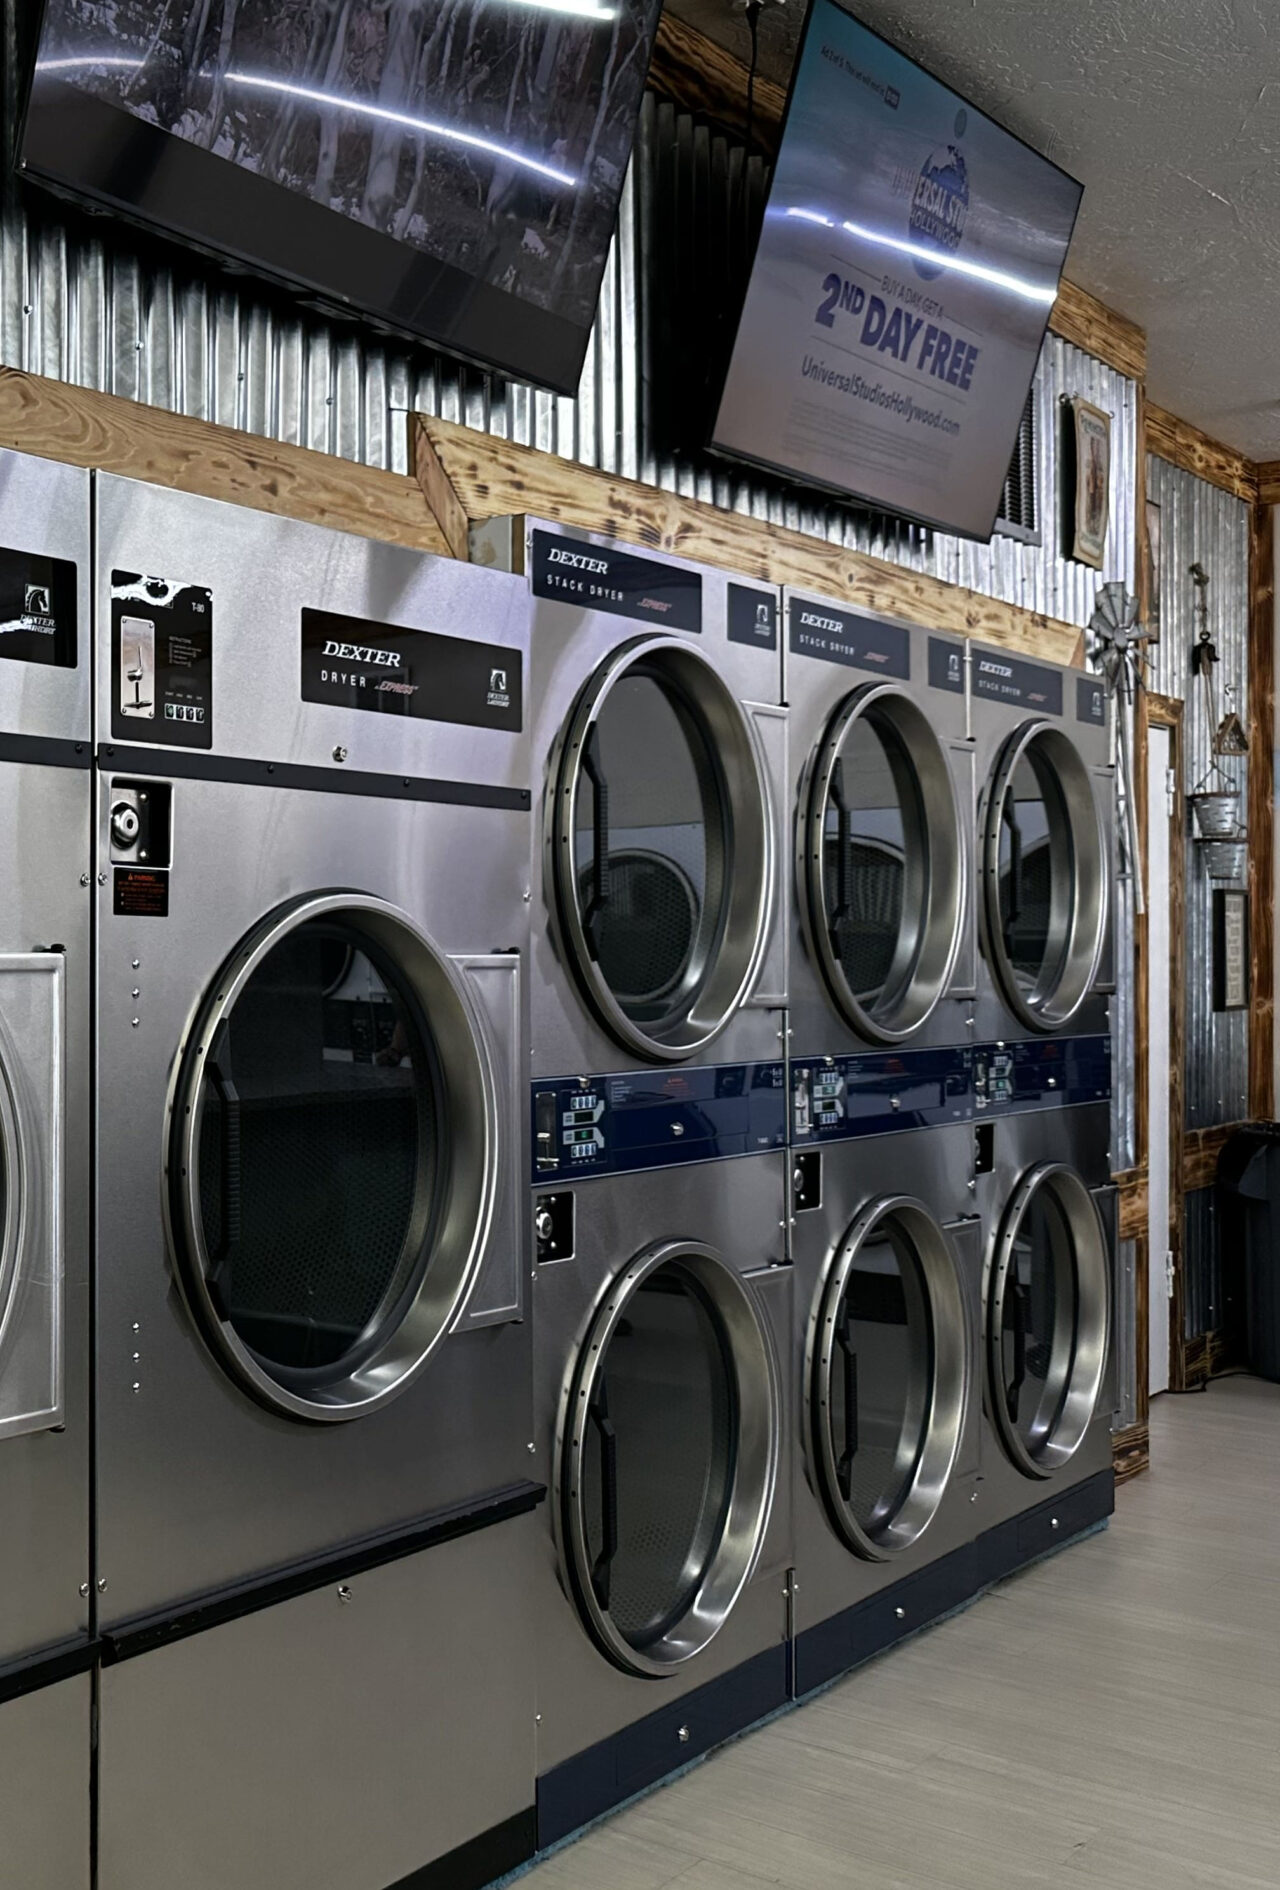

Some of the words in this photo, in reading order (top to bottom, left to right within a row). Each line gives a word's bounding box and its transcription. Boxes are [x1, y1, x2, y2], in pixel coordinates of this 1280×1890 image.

[815, 273, 865, 328] 2ND
[860, 294, 924, 362] DAY
[917, 324, 979, 391] FREE
[801, 355, 961, 437] UniversalStudiosHollywood.com
[547, 547, 609, 575] DEXTER
[546, 574, 583, 592] STACK
[589, 584, 624, 601] DRYER
[800, 612, 844, 634] DEXTER
[322, 640, 401, 668] DEXTER
[321, 669, 366, 688] DRYER
